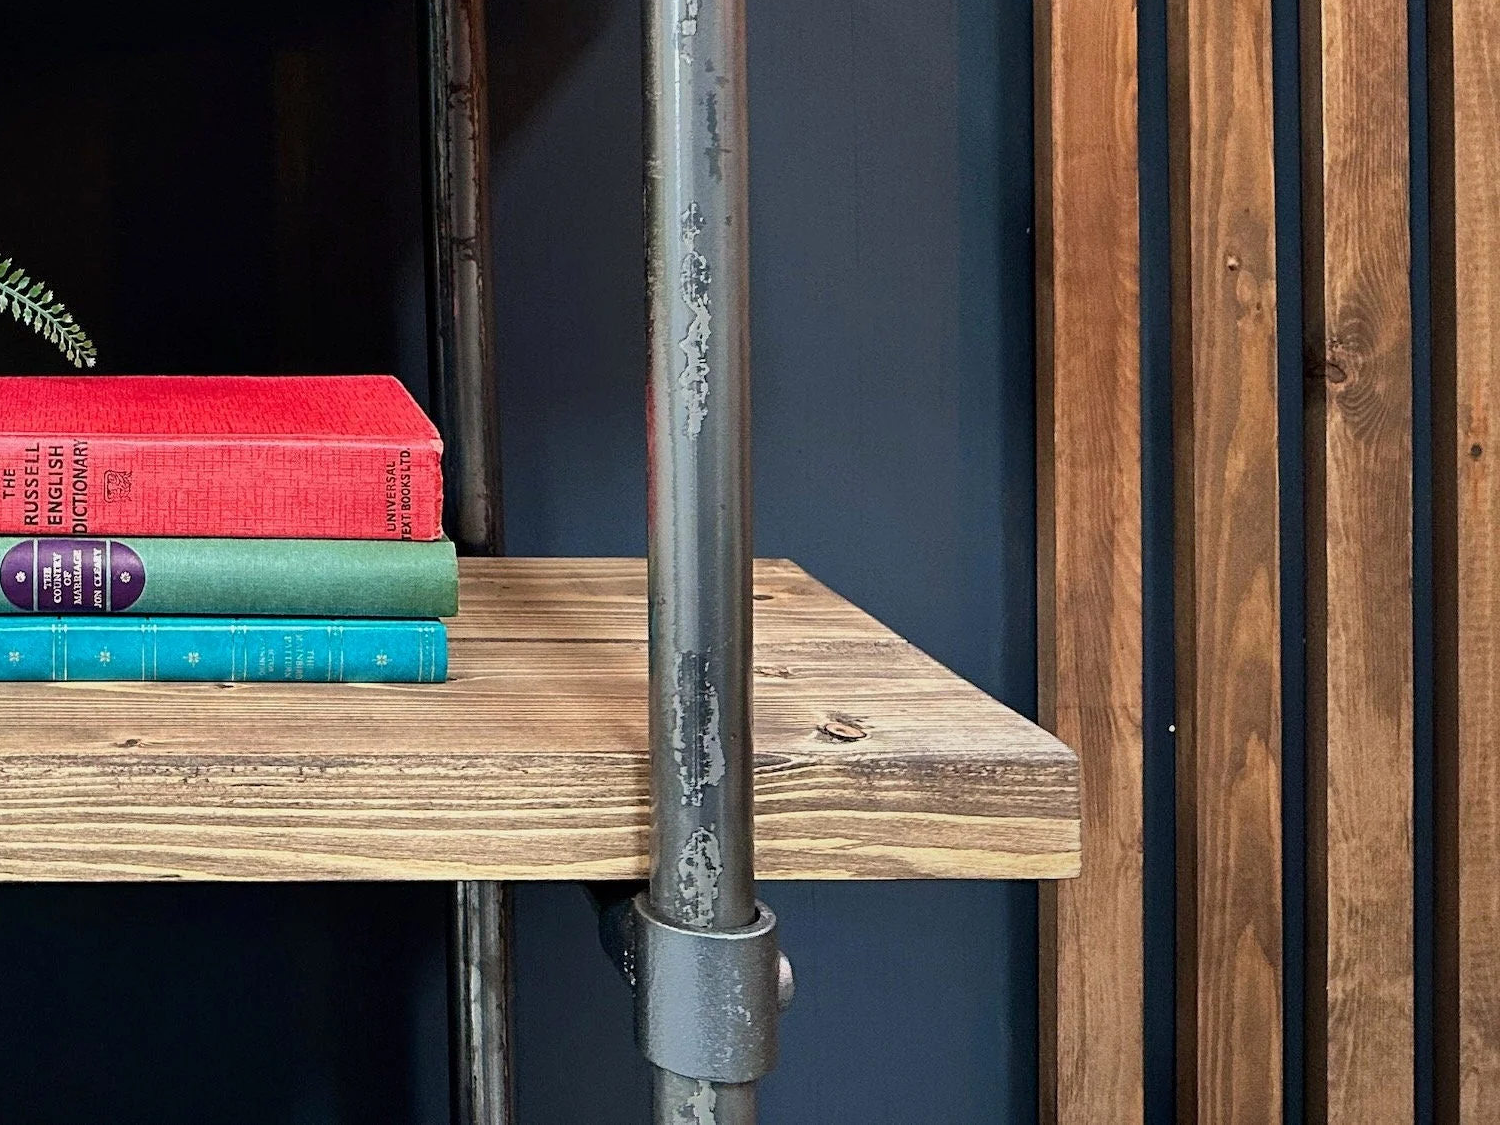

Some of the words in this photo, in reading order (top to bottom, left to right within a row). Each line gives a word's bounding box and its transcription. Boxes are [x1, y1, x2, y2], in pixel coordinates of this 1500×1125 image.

[399, 447, 412, 472] LTD.
[2, 468, 16, 499] THE
[23, 442, 40, 526] RUSSELL
[47, 445, 64, 525] ENGLISH
[72, 438, 88, 534] DICTIONARY
[385, 460, 397, 532] UNIVERSAL
[400, 473, 412, 511] BOOKS
[401, 514, 412, 540] TEXT
[43, 566, 52, 590] THE
[52, 551, 62, 604] COUNTRY
[63, 570, 72, 587] OF
[73, 549, 83, 606] MARRIAGE
[93, 547, 102, 588] CLEARY
[93, 589, 102, 608] JON
